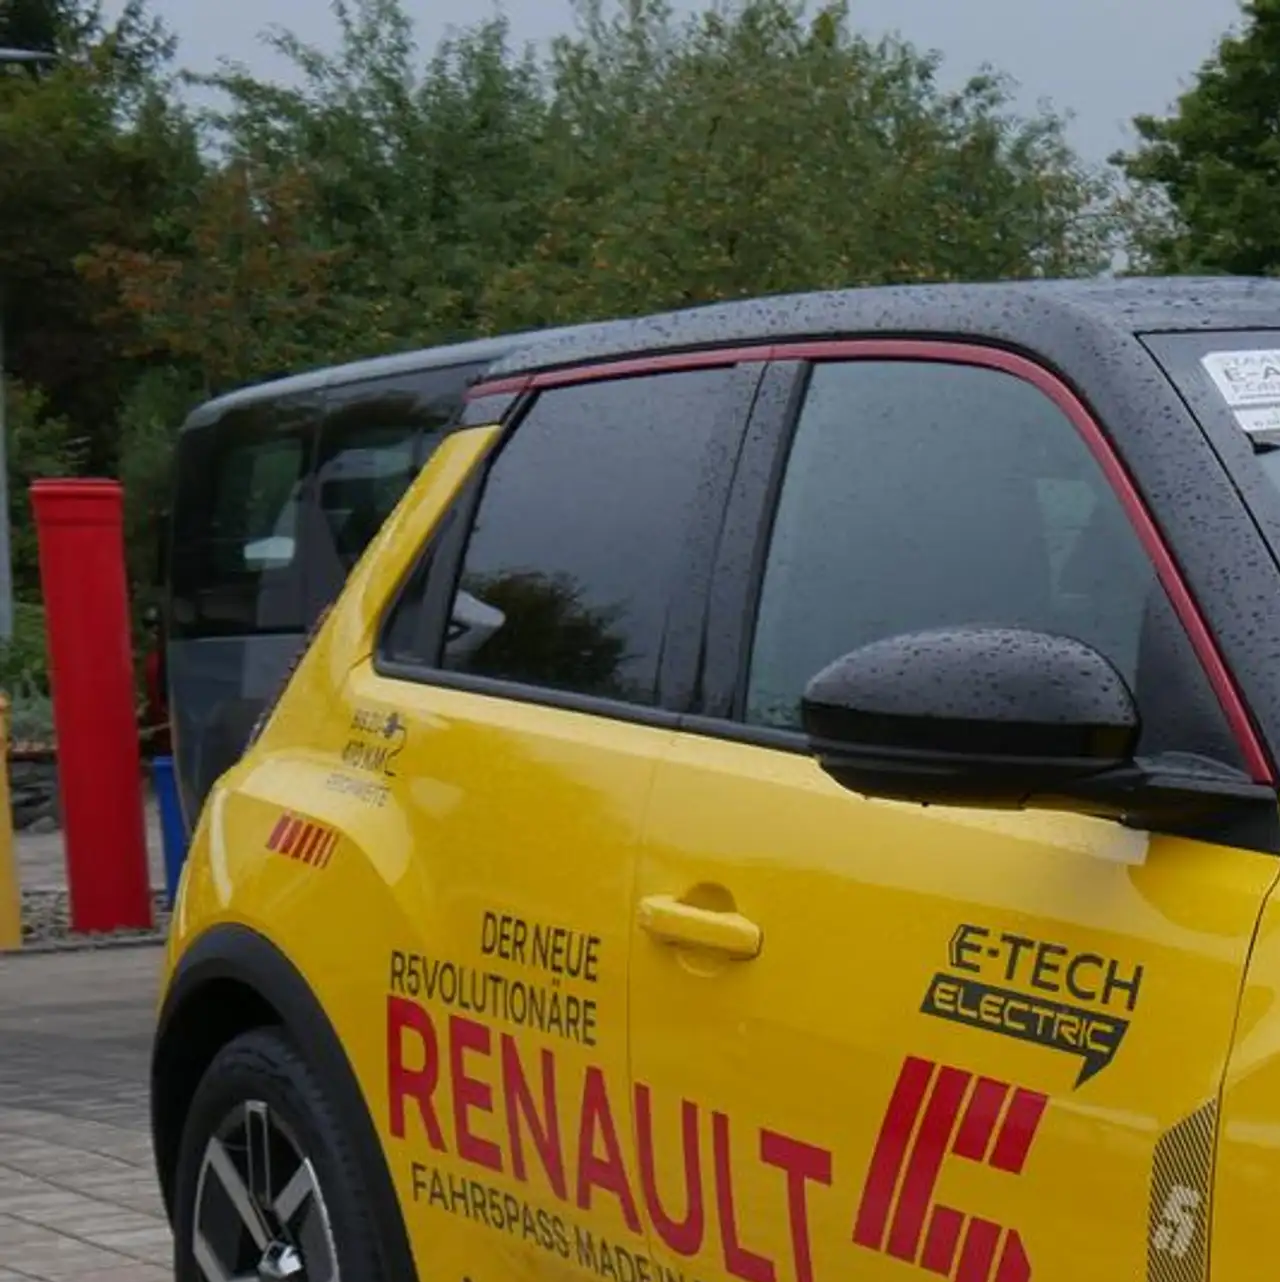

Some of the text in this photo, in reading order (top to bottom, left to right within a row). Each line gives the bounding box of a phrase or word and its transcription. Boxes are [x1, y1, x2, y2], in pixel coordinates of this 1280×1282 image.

[481, 910, 601, 984] DER NEUE
[948, 923, 1144, 1012] E-TECH
[390, 949, 598, 1047] R5VOLUTIONÄRE
[932, 981, 1115, 1054] ELECTRIC
[411, 1161, 571, 1259] FAHR5PASS
